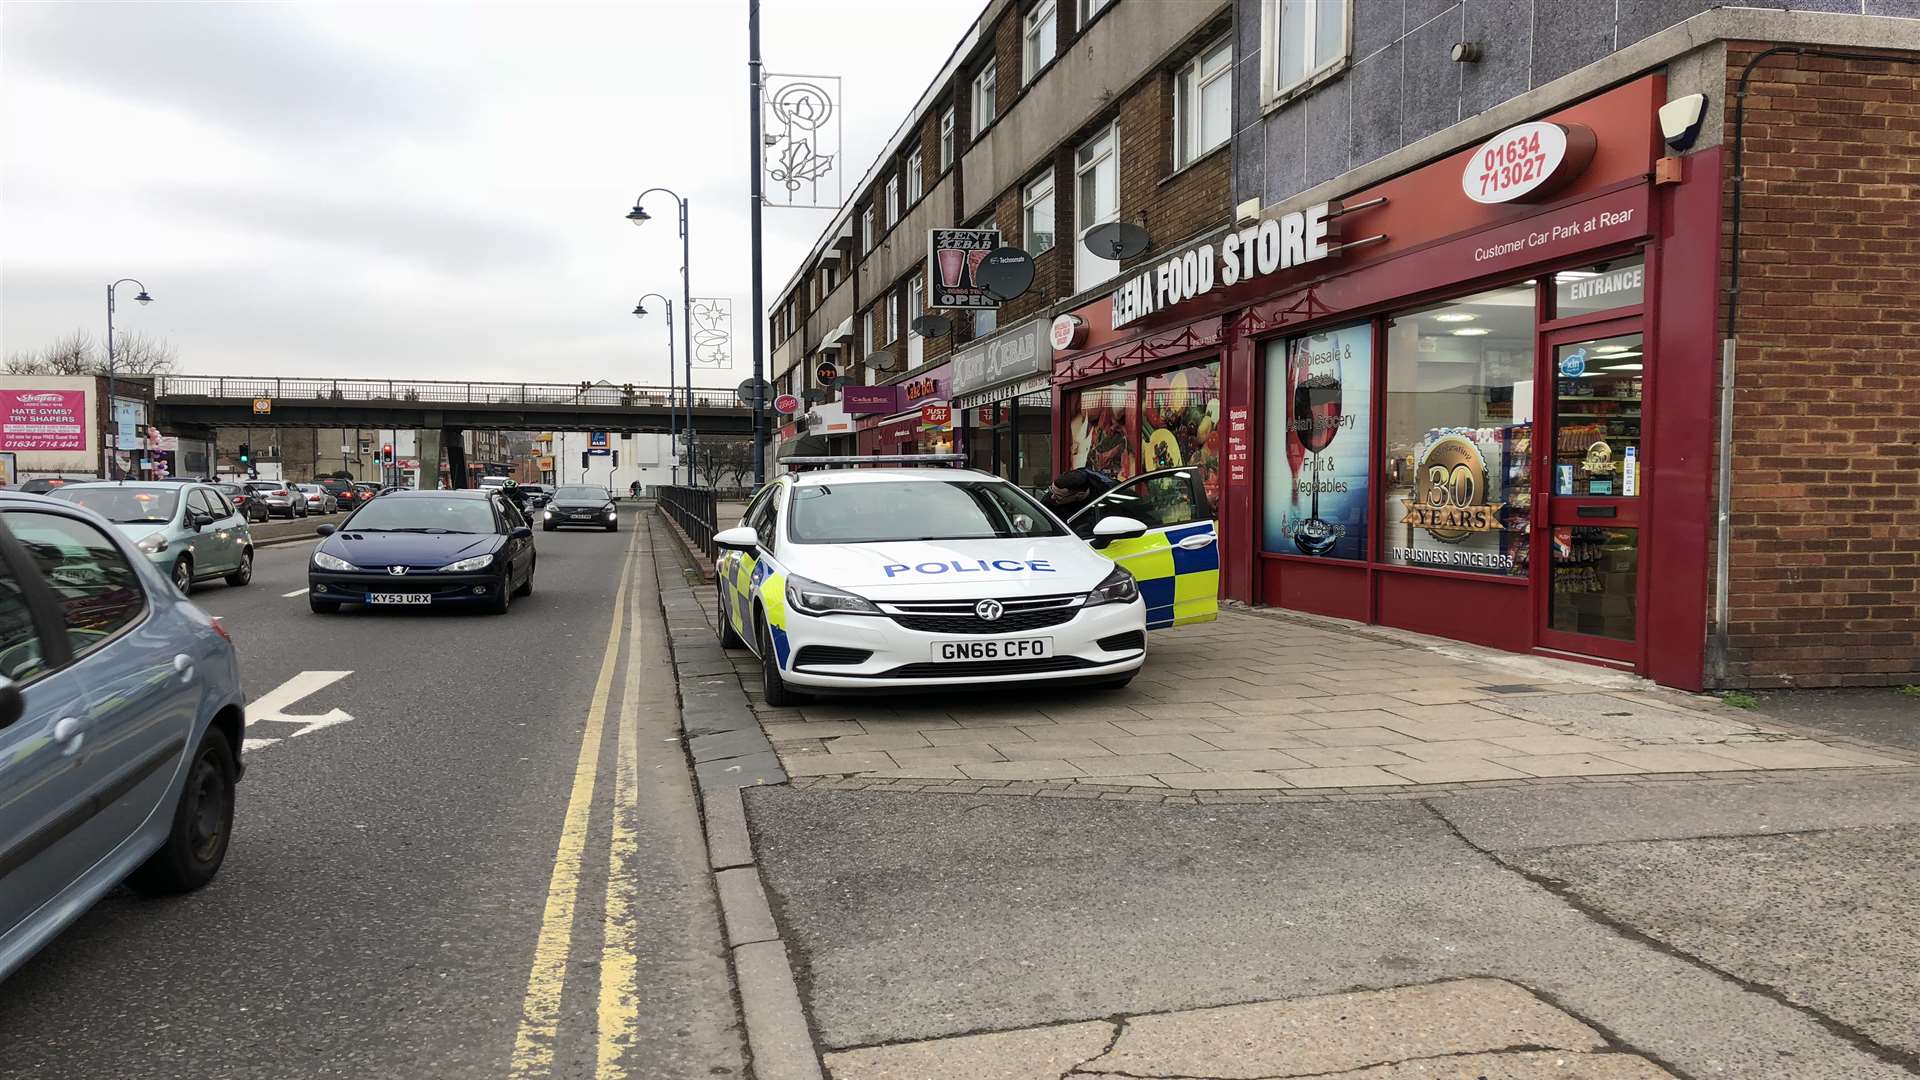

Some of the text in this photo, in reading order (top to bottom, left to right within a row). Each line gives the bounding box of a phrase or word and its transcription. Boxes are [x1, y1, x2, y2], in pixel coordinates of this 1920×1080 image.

[1484, 131, 1540, 172] 01634
[1479, 154, 1546, 196] 713027
[937, 231, 995, 240] KENT
[937, 239, 992, 249] KEBAB
[1474, 208, 1635, 262] Customer Car Park at Rear
[1111, 202, 1329, 331] REENA FOOD STORE
[1570, 270, 1642, 300] ENTRANCE
[941, 294, 994, 305] OPEN
[1344, 344, 1351, 359] &
[961, 396, 978, 409] FREE
[982, 383, 1022, 403] DELIVERY
[1229, 410, 1247, 420] Opening
[1232, 422, 1245, 430] Times
[1303, 456, 1335, 472] Fruit &
[1296, 478, 1348, 496] Vegetables
[1428, 464, 1475, 510] 30
[1418, 509, 1486, 529] YEARS
[1392, 547, 1402, 559] IN
[1404, 548, 1448, 564] BUSINESS
[1454, 551, 1484, 567] SINCE
[883, 559, 1057, 577] POLICE
[373, 594, 430, 602] KY53 URX
[942, 640, 1044, 660] GN66 CFO
